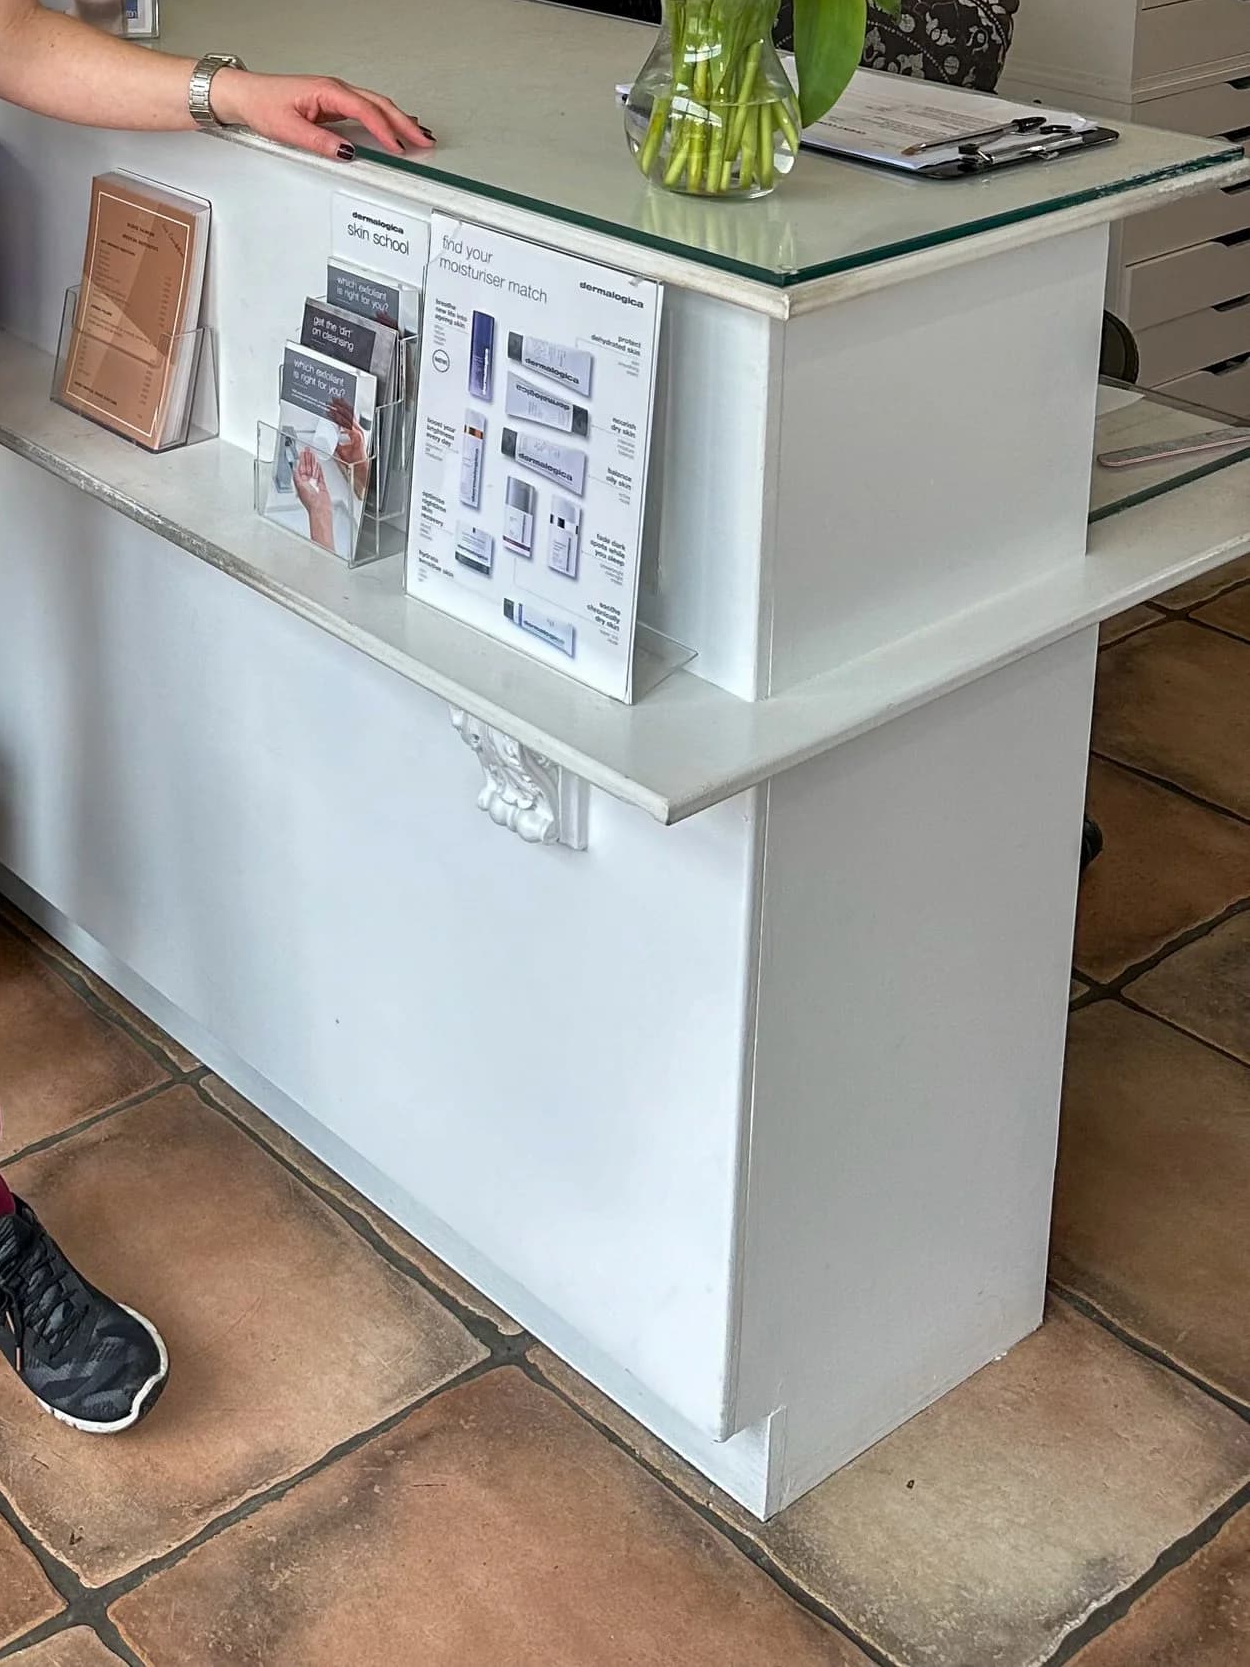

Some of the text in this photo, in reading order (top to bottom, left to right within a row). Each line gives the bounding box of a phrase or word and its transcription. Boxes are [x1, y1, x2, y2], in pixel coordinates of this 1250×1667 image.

[352, 211, 404, 234] dermalogica
[347, 223, 409, 255] skin school
[442, 234, 493, 264] find your
[336, 276, 357, 291] which
[439, 255, 548, 304] moisturiser match
[344, 288, 359, 304] right
[579, 280, 644, 309] dermalogica
[326, 319, 337, 332] the
[434, 314, 466, 329] ageing skin
[322, 329, 354, 352] cleansing
[591, 334, 641, 356] dehydrated skin
[618, 336, 641, 348] protect
[293, 359, 315, 374] which
[525, 357, 580, 384] dermalogica
[300, 372, 316, 387] right
[328, 384, 346, 397] you?
[441, 437, 452, 448] day
[610, 424, 636, 439] dry skin
[518, 453, 573, 482] dermalogica
[618, 479, 632, 490] skin
